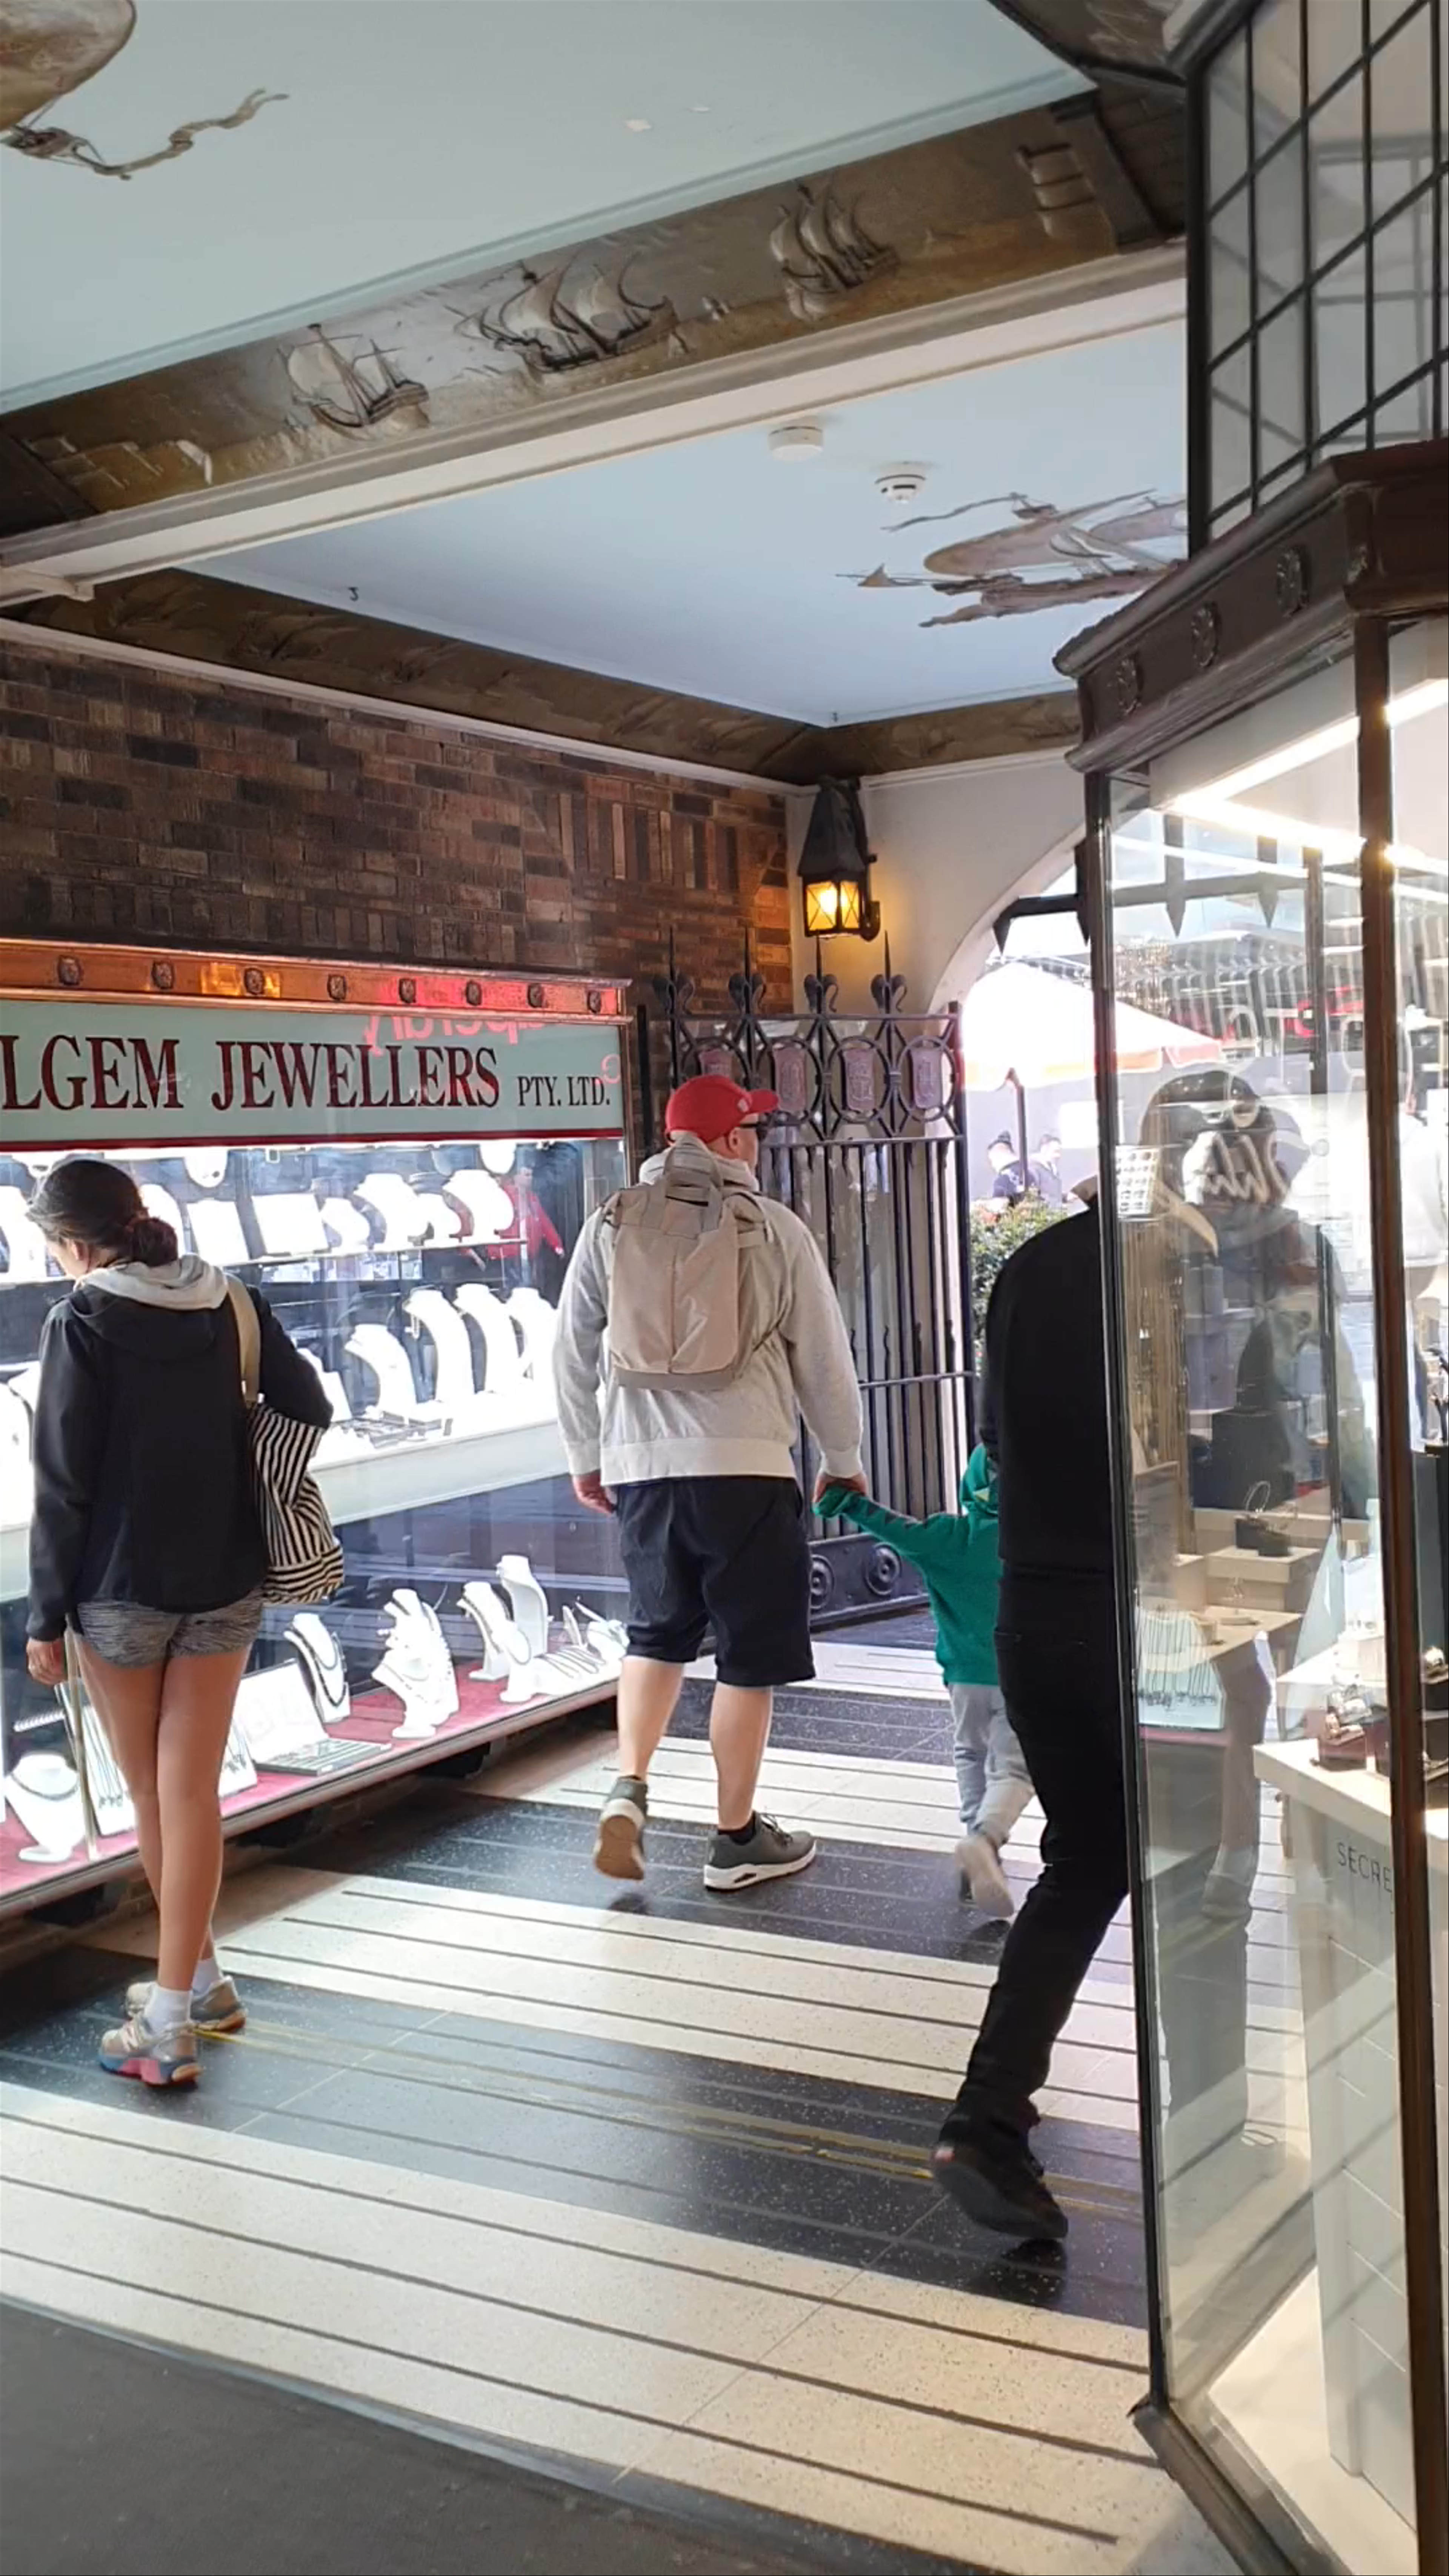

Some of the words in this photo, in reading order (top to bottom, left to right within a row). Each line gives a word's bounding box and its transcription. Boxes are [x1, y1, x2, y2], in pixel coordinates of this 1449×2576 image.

[0, 1035, 184, 1110] LGEM
[211, 1041, 499, 1110] JEWELLERS
[517, 1076, 561, 1106] PTY.
[567, 1076, 610, 1106] LTD.
